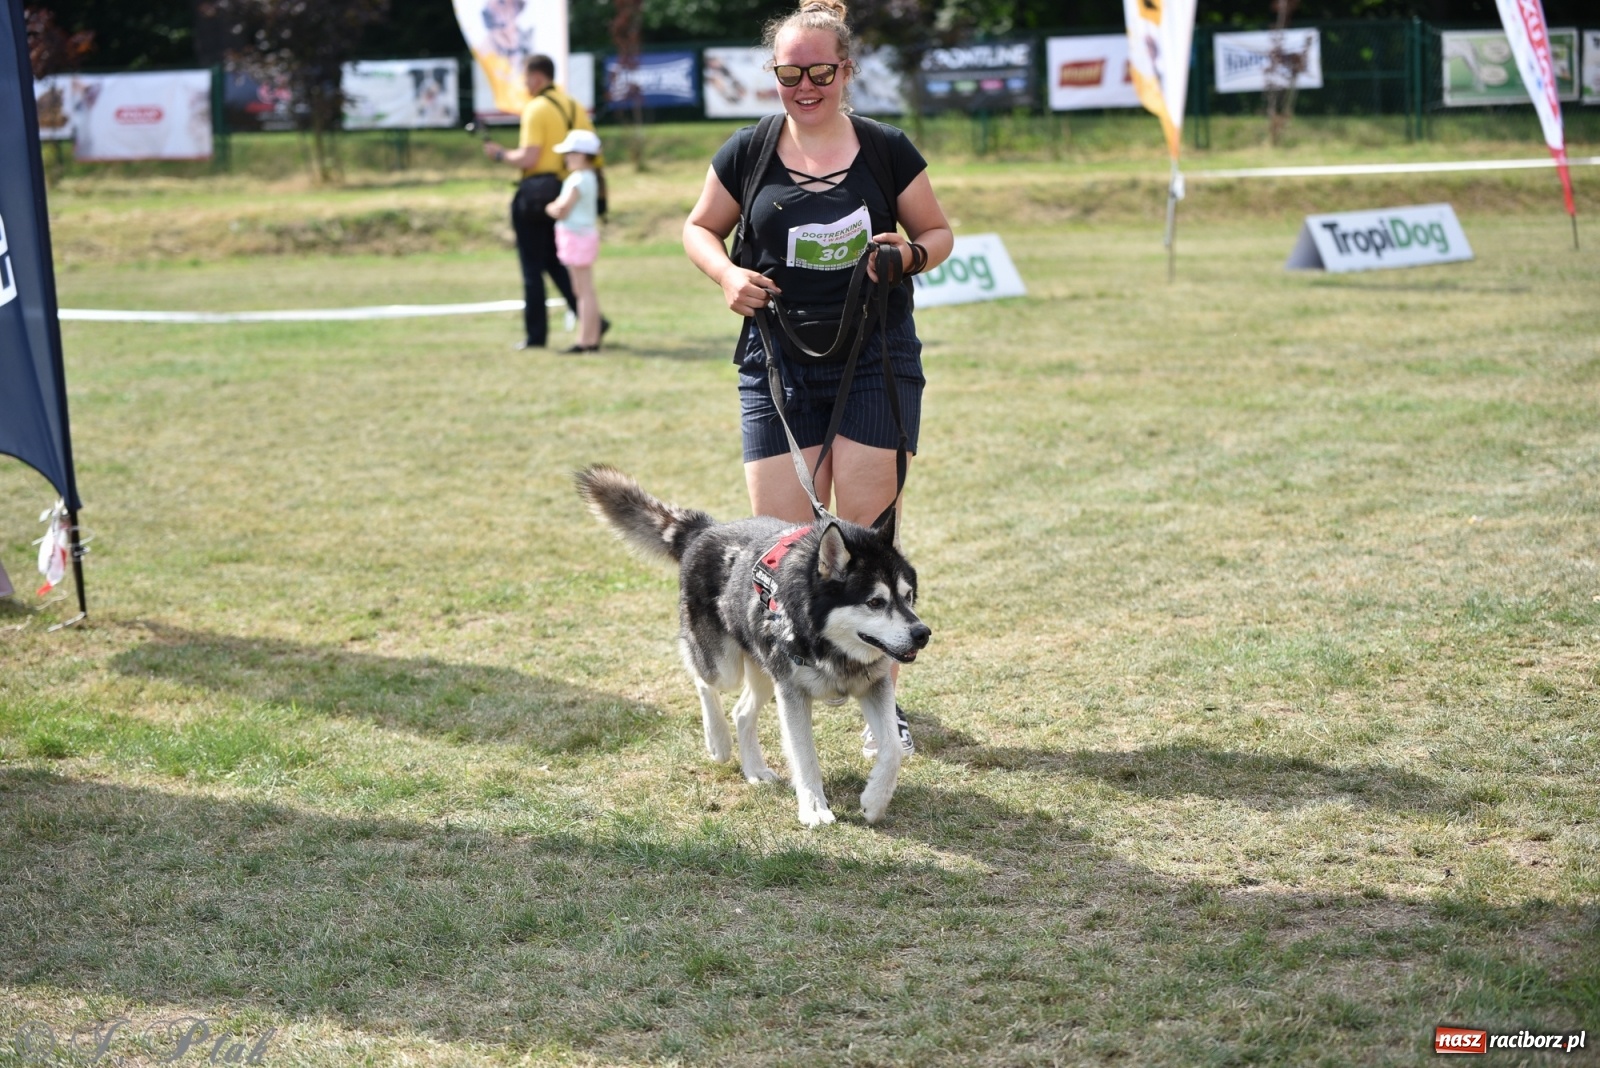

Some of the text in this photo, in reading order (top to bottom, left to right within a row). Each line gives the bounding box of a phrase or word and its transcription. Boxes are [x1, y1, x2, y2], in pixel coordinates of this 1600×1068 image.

[802, 219, 862, 239] DOGTREKKING
[1320, 217, 1450, 259] TropiDog
[818, 245, 849, 262] 30
